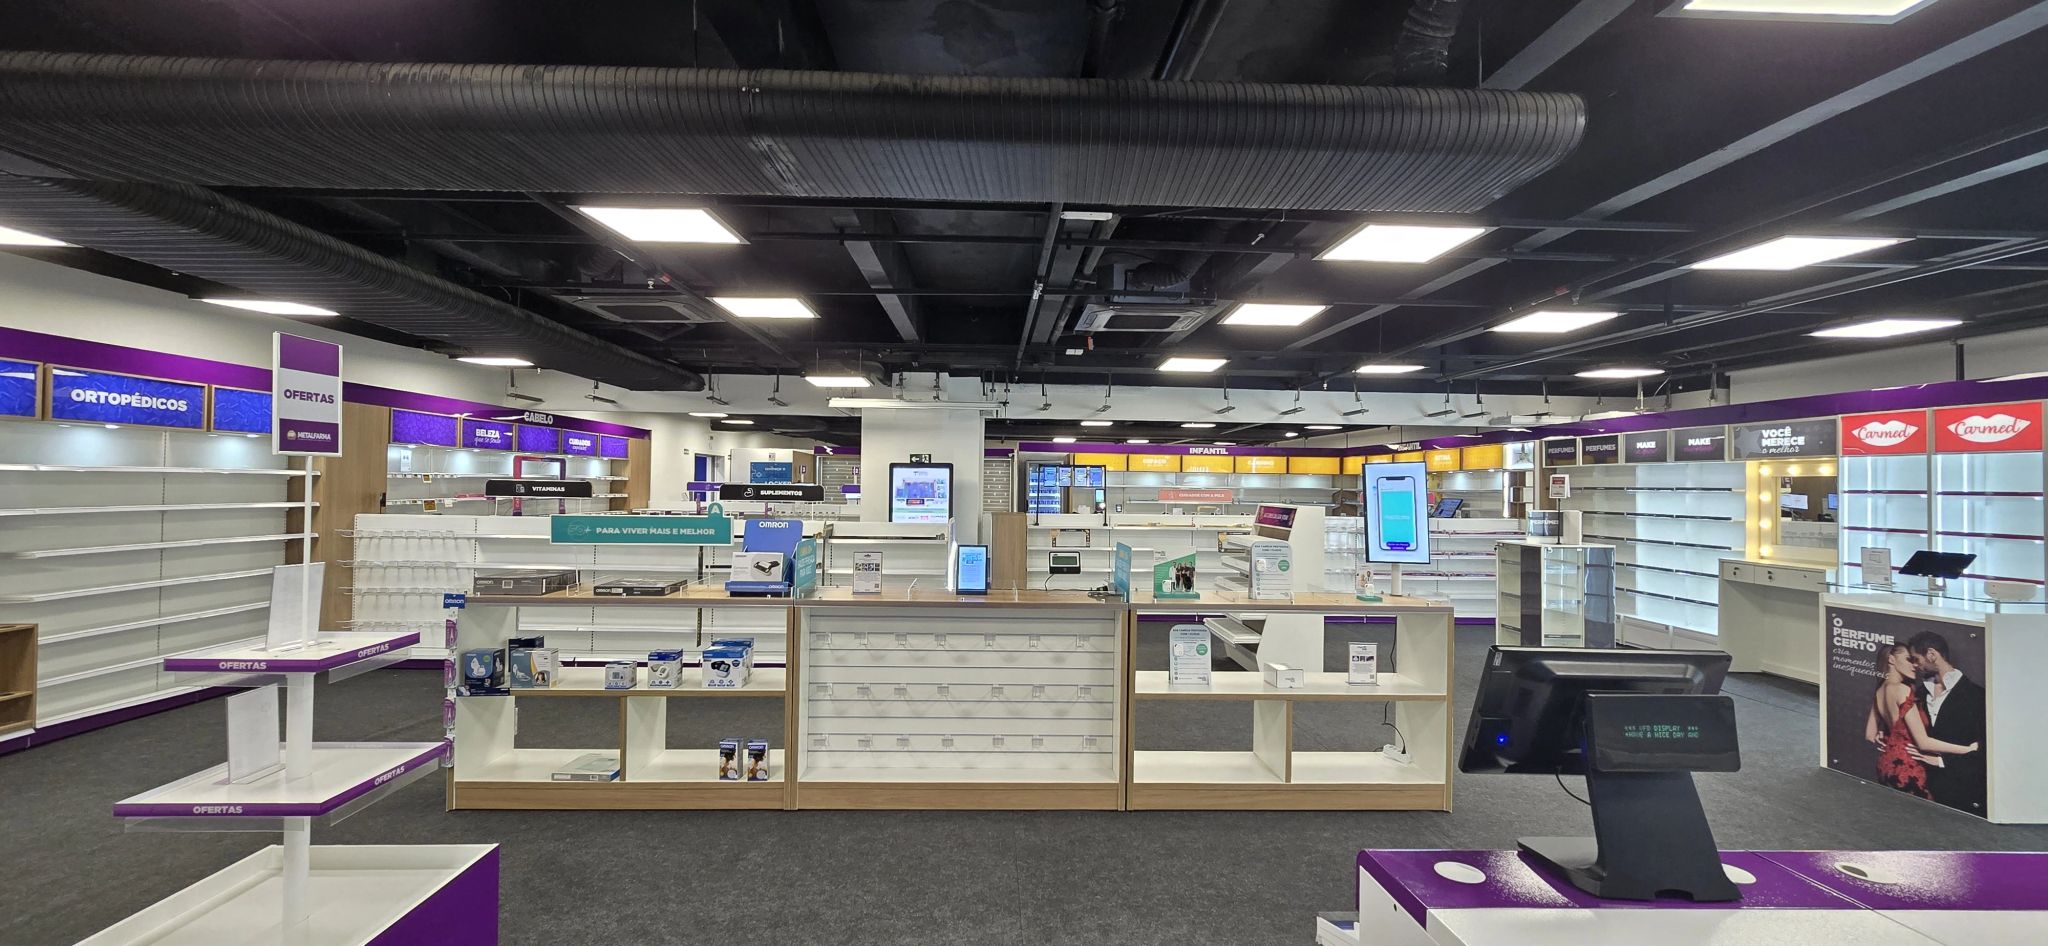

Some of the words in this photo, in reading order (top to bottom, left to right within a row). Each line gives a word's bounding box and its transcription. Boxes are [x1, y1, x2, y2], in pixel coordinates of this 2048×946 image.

[71, 388, 188, 412] ORTOPÉDICOS
[284, 389, 334, 404] OFERTAS
[524, 412, 553, 424] CABELO
[1762, 426, 1792, 438] VOCÊ
[1857, 424, 1911, 441] Carmed
[1955, 418, 2019, 437] Carmed
[475, 429, 500, 439] BELEZA
[1636, 441, 1656, 449] MAKE
[1687, 438, 1711, 446] MAKE
[1761, 436, 1806, 447] MERECE
[1189, 447, 1229, 455] INFANTIL
[1548, 446, 1575, 454] PERFUMES
[1585, 444, 1616, 452] PERFUMES
[710, 505, 720, 514] A
[759, 521, 789, 529] OMRON
[596, 527, 621, 535] PARA
[621, 527, 648, 535] VIVER
[650, 527, 671, 535] MAIS
[679, 528, 715, 536] MELHOR
[1833, 617, 1843, 627] O
[1833, 626, 1895, 646] PERFUME
[1833, 636, 1877, 652] CERTO
[357, 643, 390, 658] OFERTAS
[219, 661, 267, 670] OFERTAS
[1832, 656, 1877, 669] momentos
[374, 765, 405, 785] OFERTAS
[193, 805, 243, 814] OFERTAS
